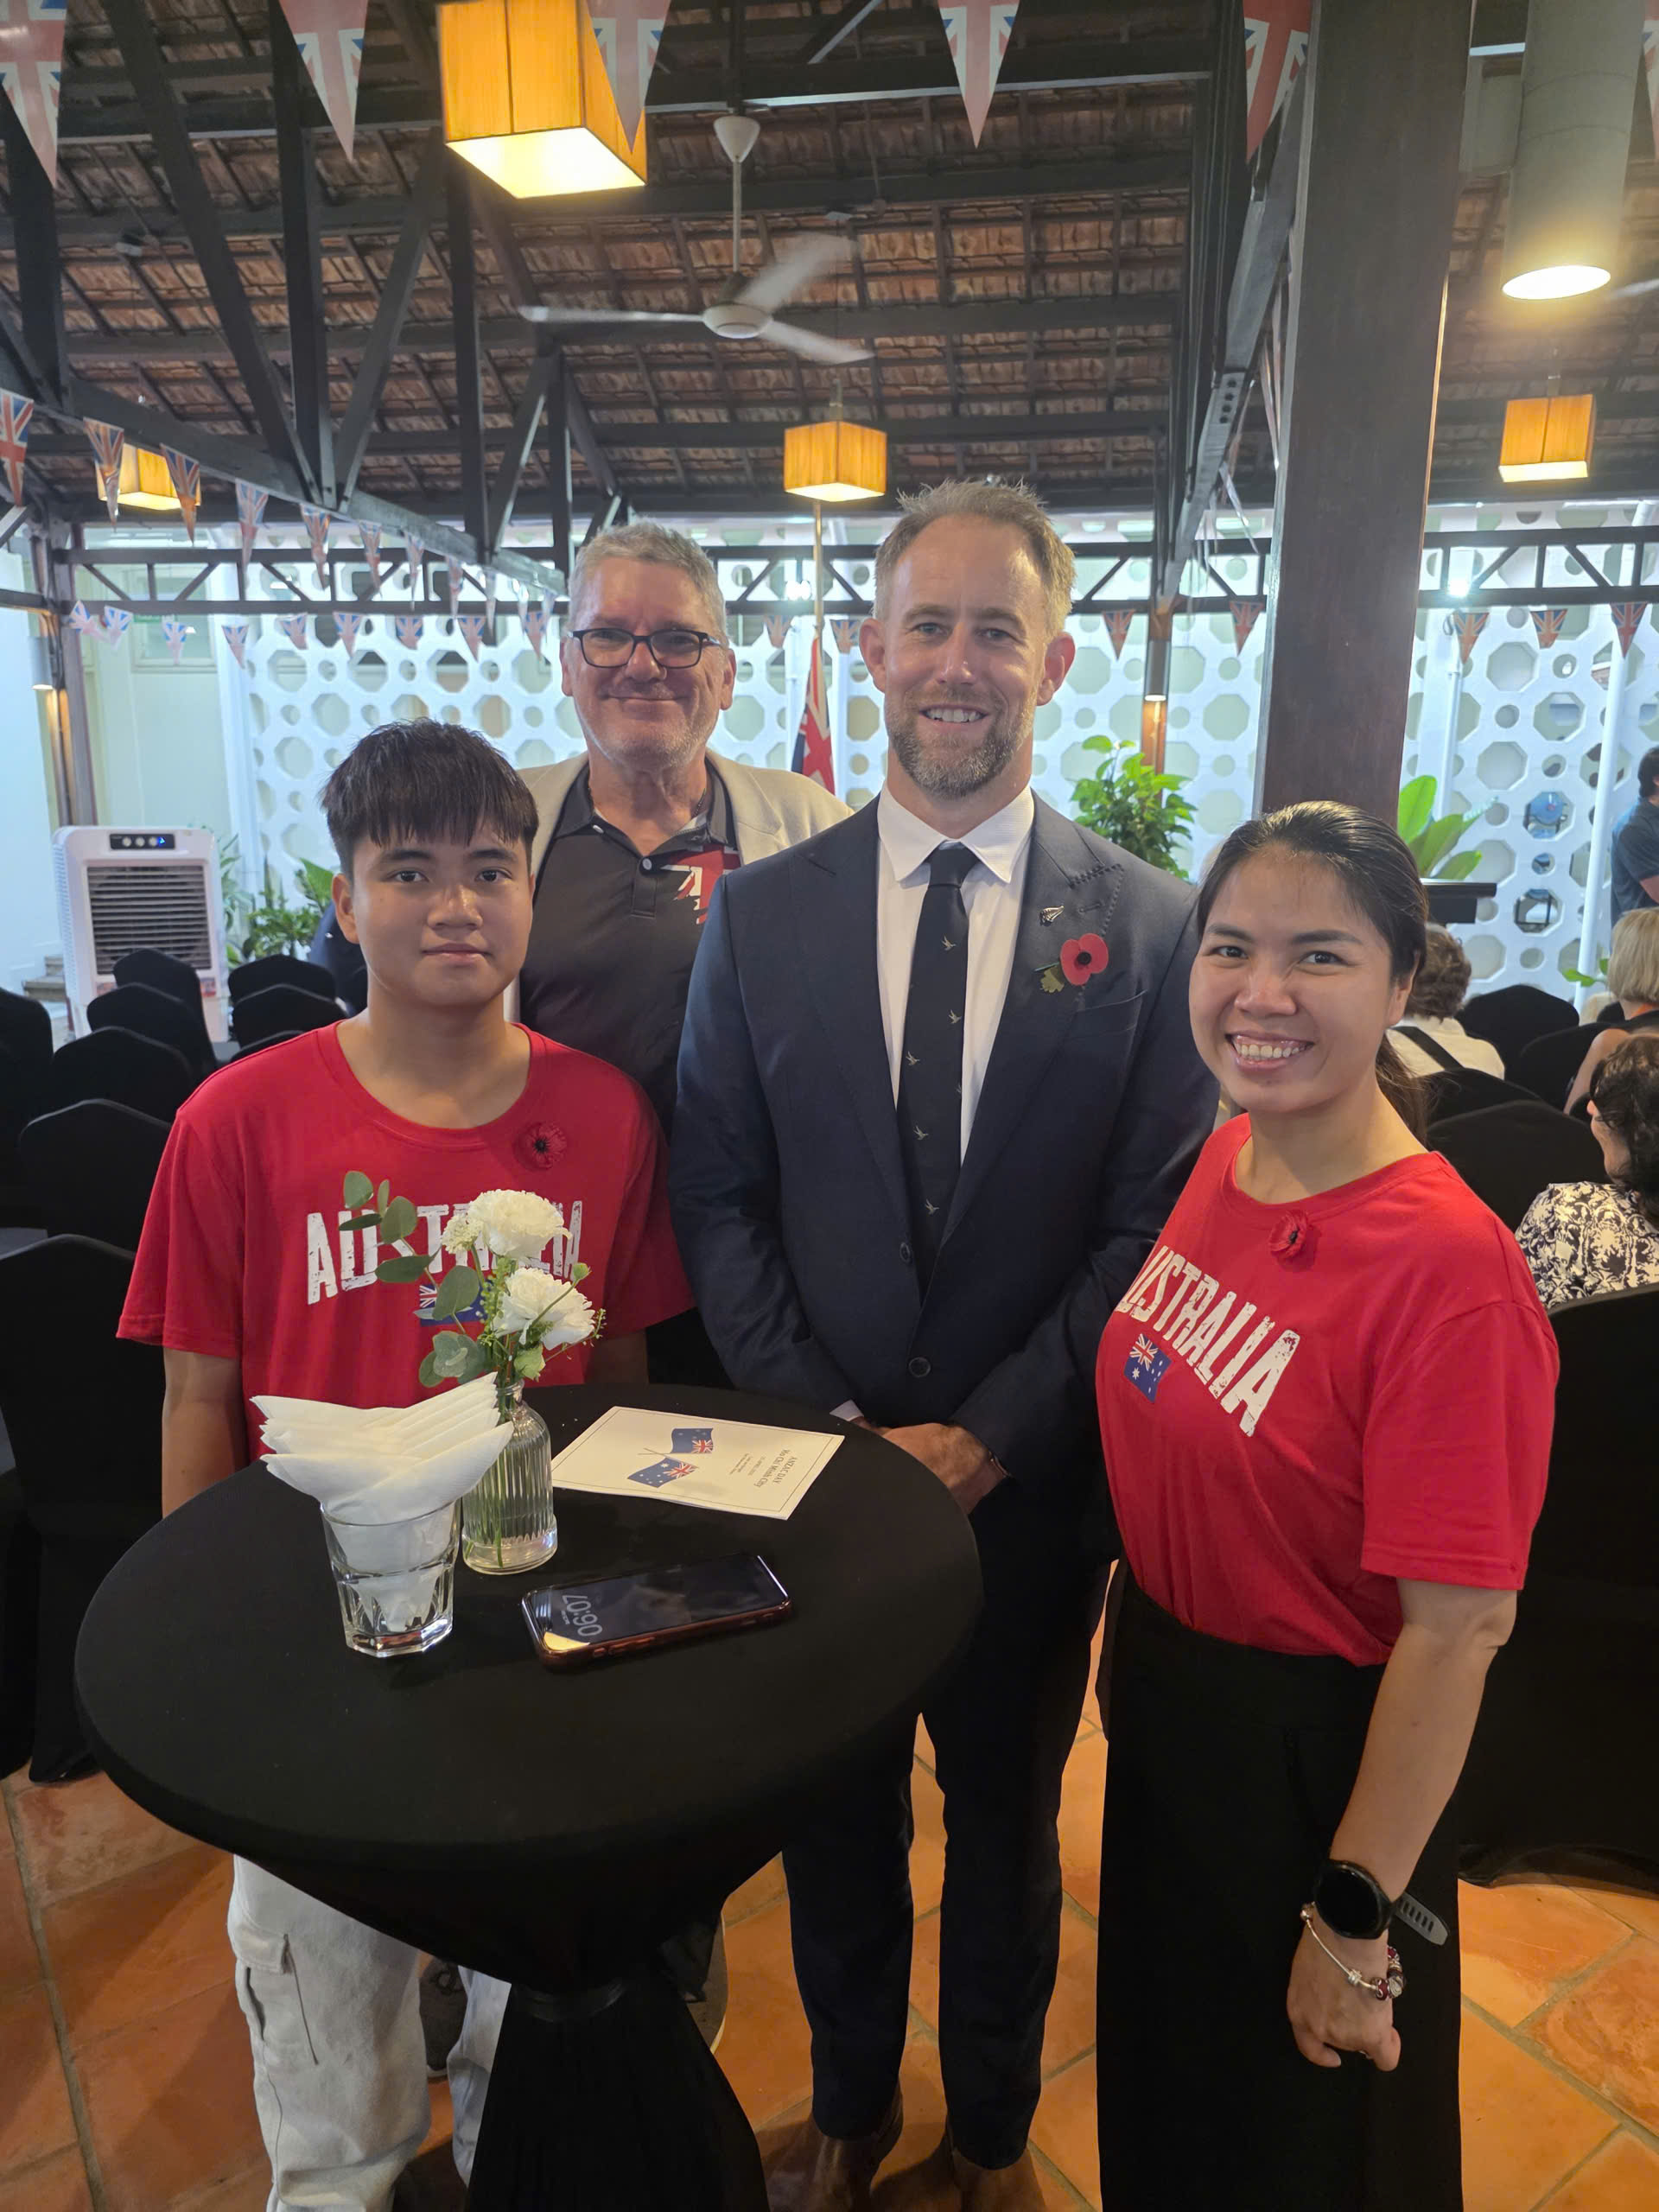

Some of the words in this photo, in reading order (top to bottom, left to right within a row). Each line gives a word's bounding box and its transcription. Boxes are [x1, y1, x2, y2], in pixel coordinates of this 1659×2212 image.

[307, 1200, 582, 1305] AUTIA
[1115, 1245, 1300, 1437] USTRALIA
[762, 1465, 778, 1478] Minh
[780, 1456, 798, 1472] ANZAC
[753, 1478, 768, 1488] City
[772, 1472, 785, 1484] DAY
[562, 1595, 603, 1637] 06:07
